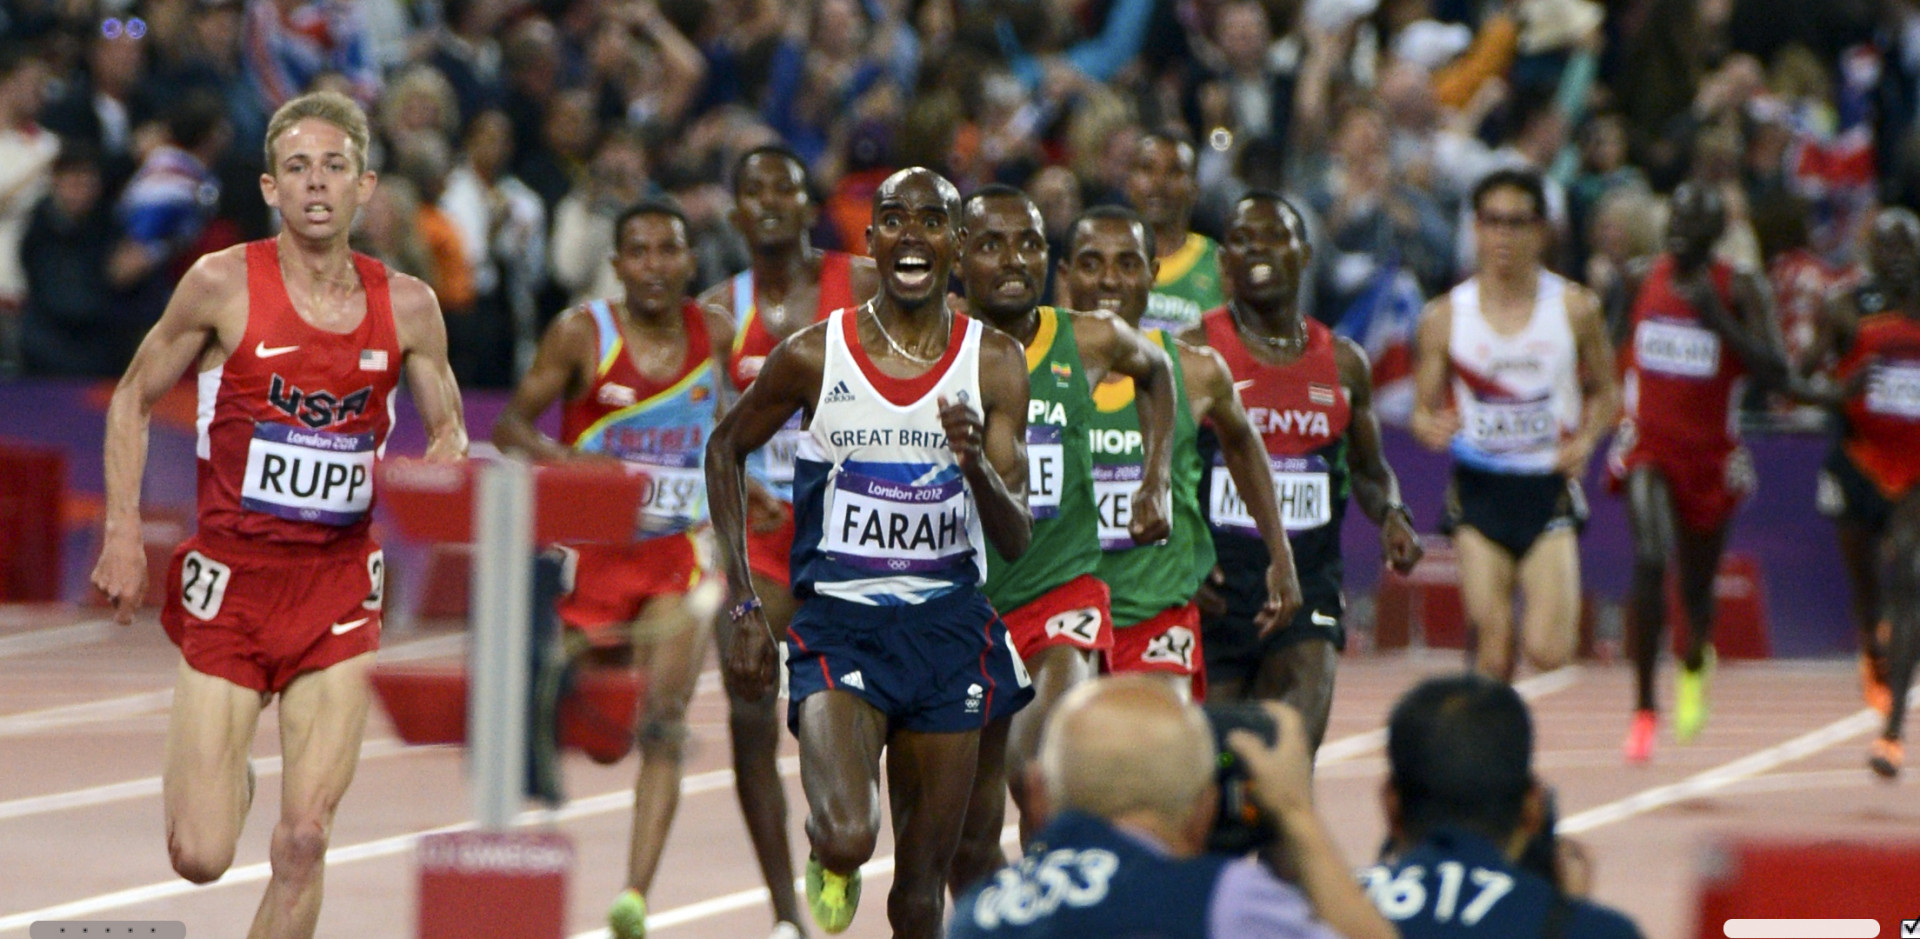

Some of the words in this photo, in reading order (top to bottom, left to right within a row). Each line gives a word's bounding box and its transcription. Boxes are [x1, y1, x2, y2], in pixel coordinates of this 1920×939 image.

[268, 372, 373, 430] USA
[824, 394, 856, 405] adidas
[1027, 399, 1068, 427] PIA
[286, 429, 332, 449] London
[333, 433, 358, 450] 2012
[829, 429, 893, 448] GREAT
[259, 453, 366, 504] RUPP
[868, 481, 912, 500] London
[915, 486, 943, 501] 2012
[842, 503, 957, 551] FARAH
